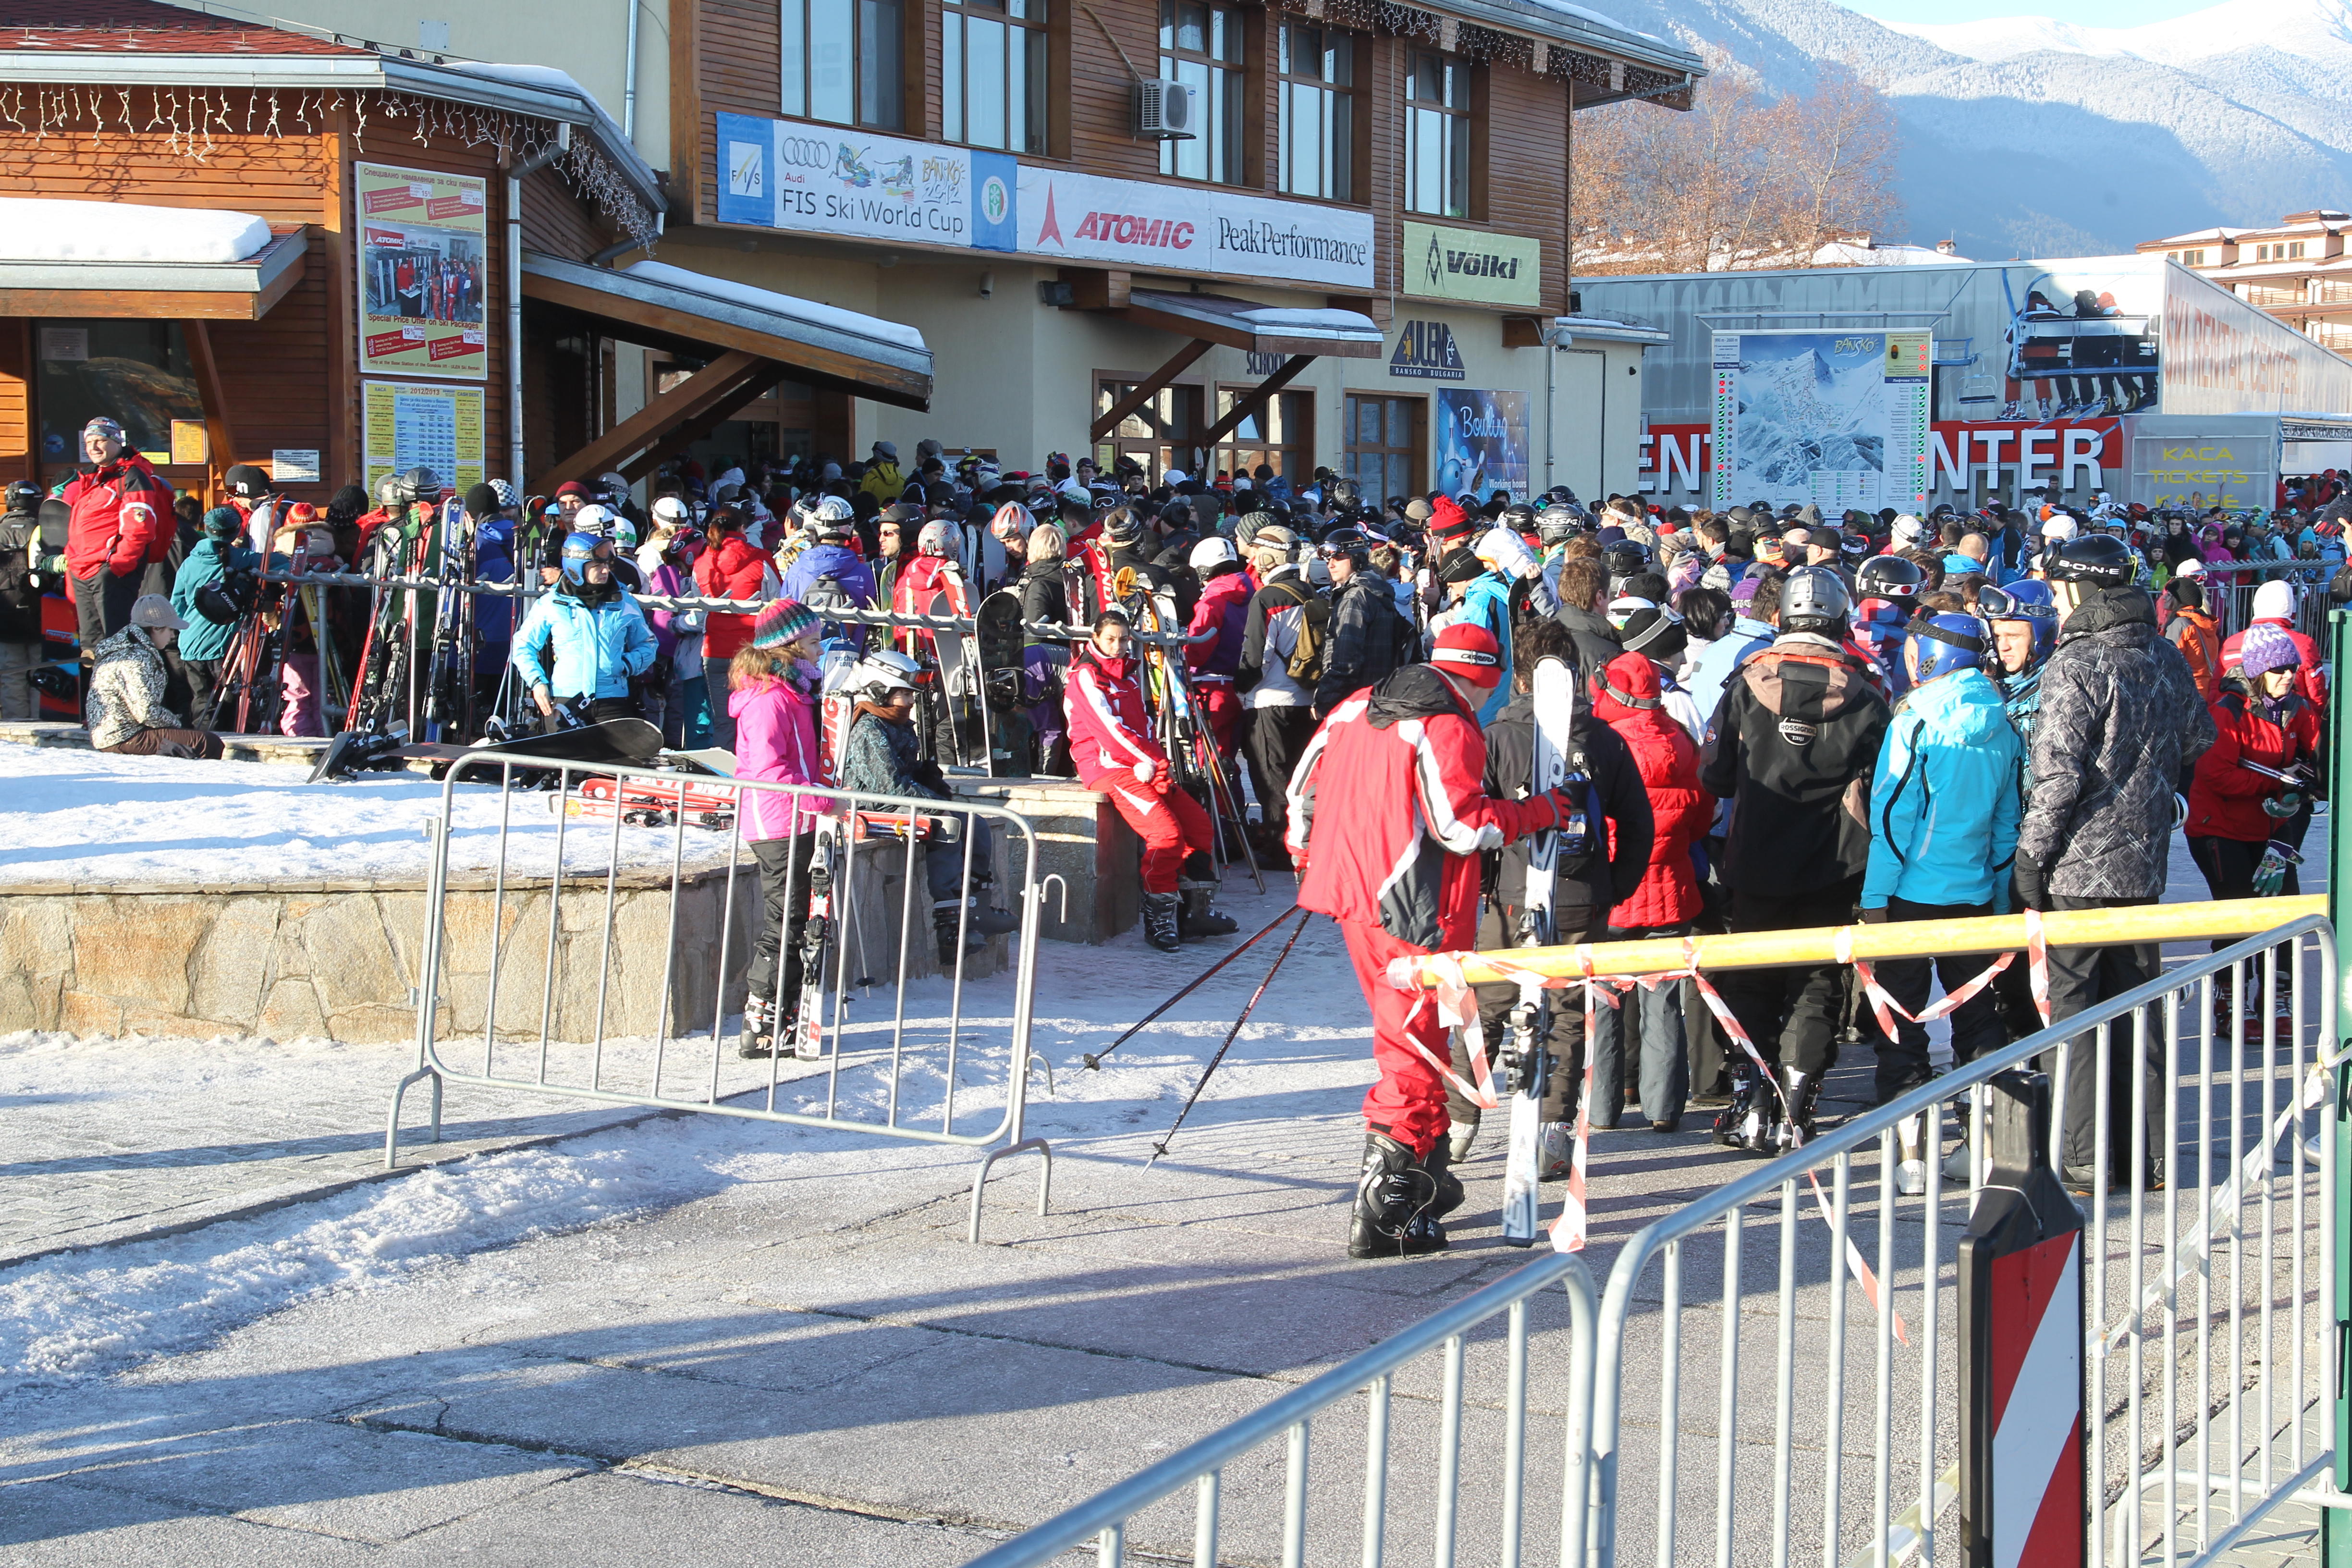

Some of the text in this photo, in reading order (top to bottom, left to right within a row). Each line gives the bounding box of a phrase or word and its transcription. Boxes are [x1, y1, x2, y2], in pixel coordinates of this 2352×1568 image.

[784, 172, 805, 184] Audi
[922, 156, 962, 184] BANSKO
[922, 183, 962, 205] 2012
[783, 189, 963, 237] FIS Ski World Cup
[375, 236, 404, 245] ATOMIC
[1073, 211, 1195, 250] ATOMIC
[1446, 249, 1518, 280] Völkl
[368, 313, 391, 323] Special
[393, 315, 409, 323] Price
[411, 316, 427, 325] Offer
[451, 320, 479, 330] Packages
[1834, 337, 1875, 357] BANSKO
[2195, 306, 2244, 391] RENTAL
[2249, 333, 2298, 395] CENTER
[1395, 367, 1463, 379] BANSKO BULGARIA
[410, 387, 440, 395] 2012/2013
[1460, 405, 1508, 439] Bowling
[1489, 479, 1527, 490] Working hours
[2149, 470, 2248, 484] TICKETS
[220, 591, 238, 612] BRIKO
[1460, 653, 1495, 663] CARRERA
[1780, 724, 1816, 735] ROSSIGNOL
[820, 697, 841, 787] TOMIC
[798, 989, 812, 1053] RACE
